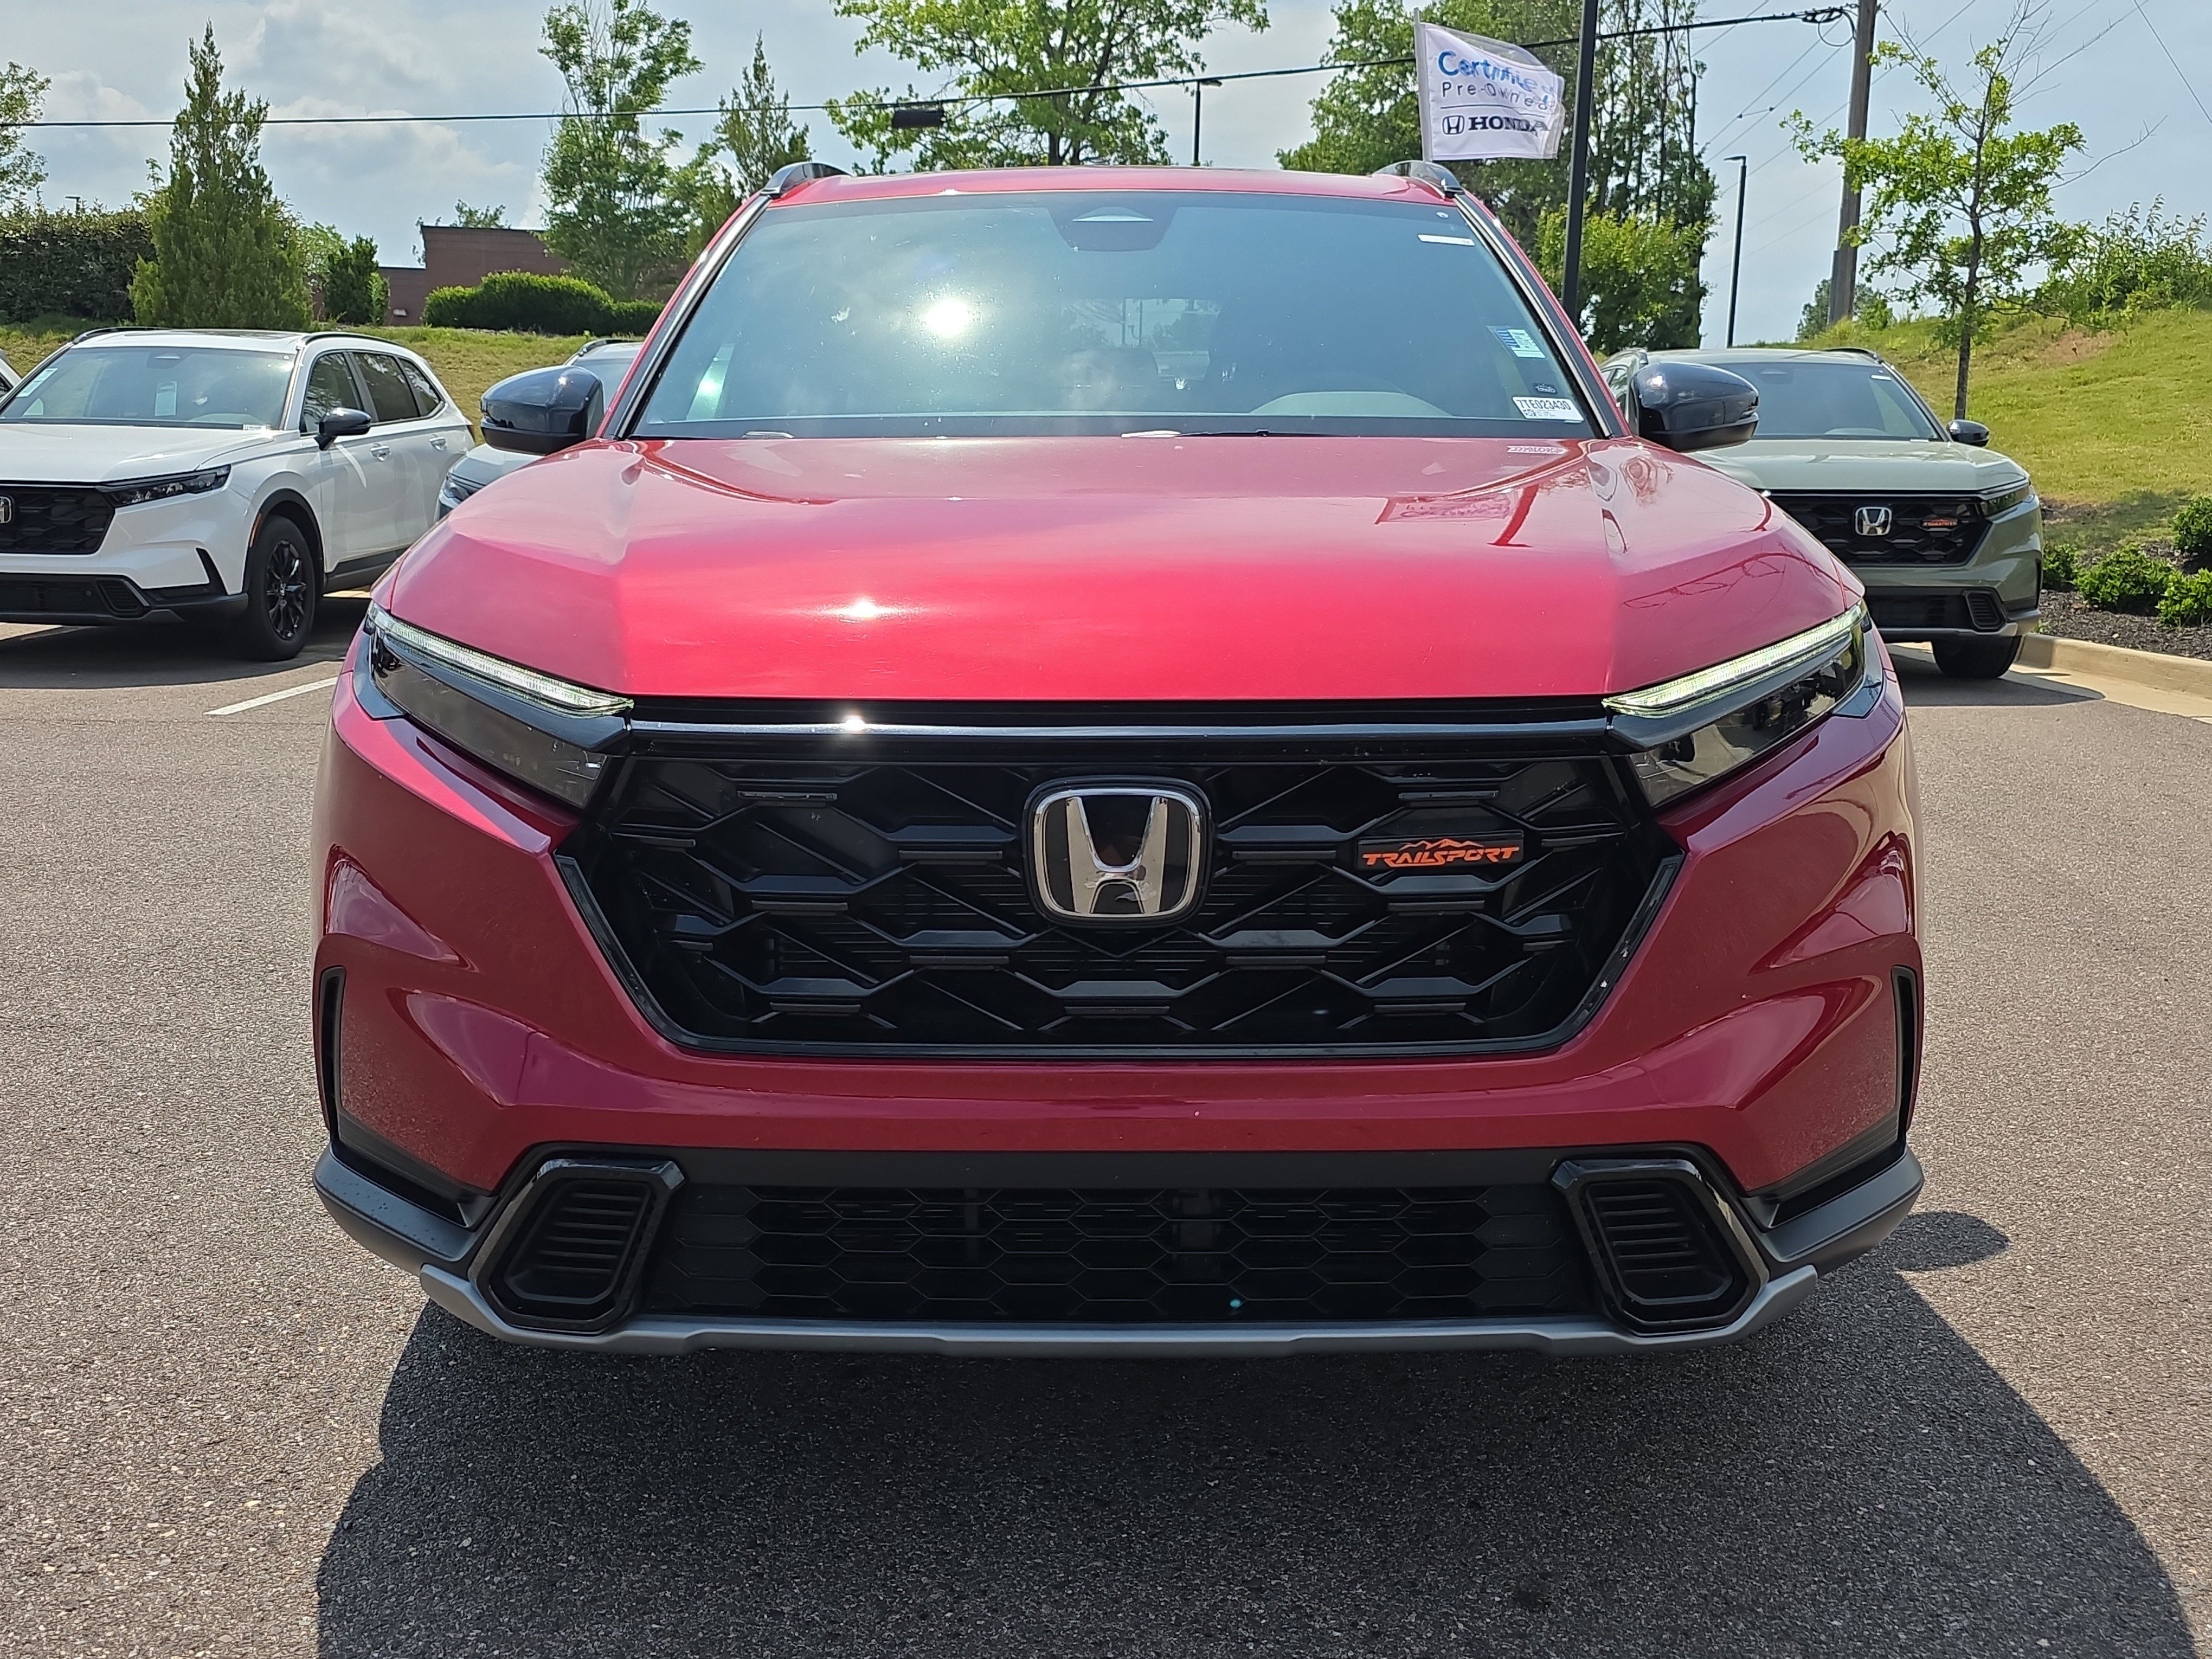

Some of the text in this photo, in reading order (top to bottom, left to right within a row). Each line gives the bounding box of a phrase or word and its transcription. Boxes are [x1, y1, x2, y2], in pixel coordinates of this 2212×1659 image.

[1442, 81, 1552, 111] Pre-Owned
[1468, 115, 1550, 136] HONDA
[1516, 399, 1572, 410] 7TE023430
[1362, 846, 1520, 868] TRAILSPORT
